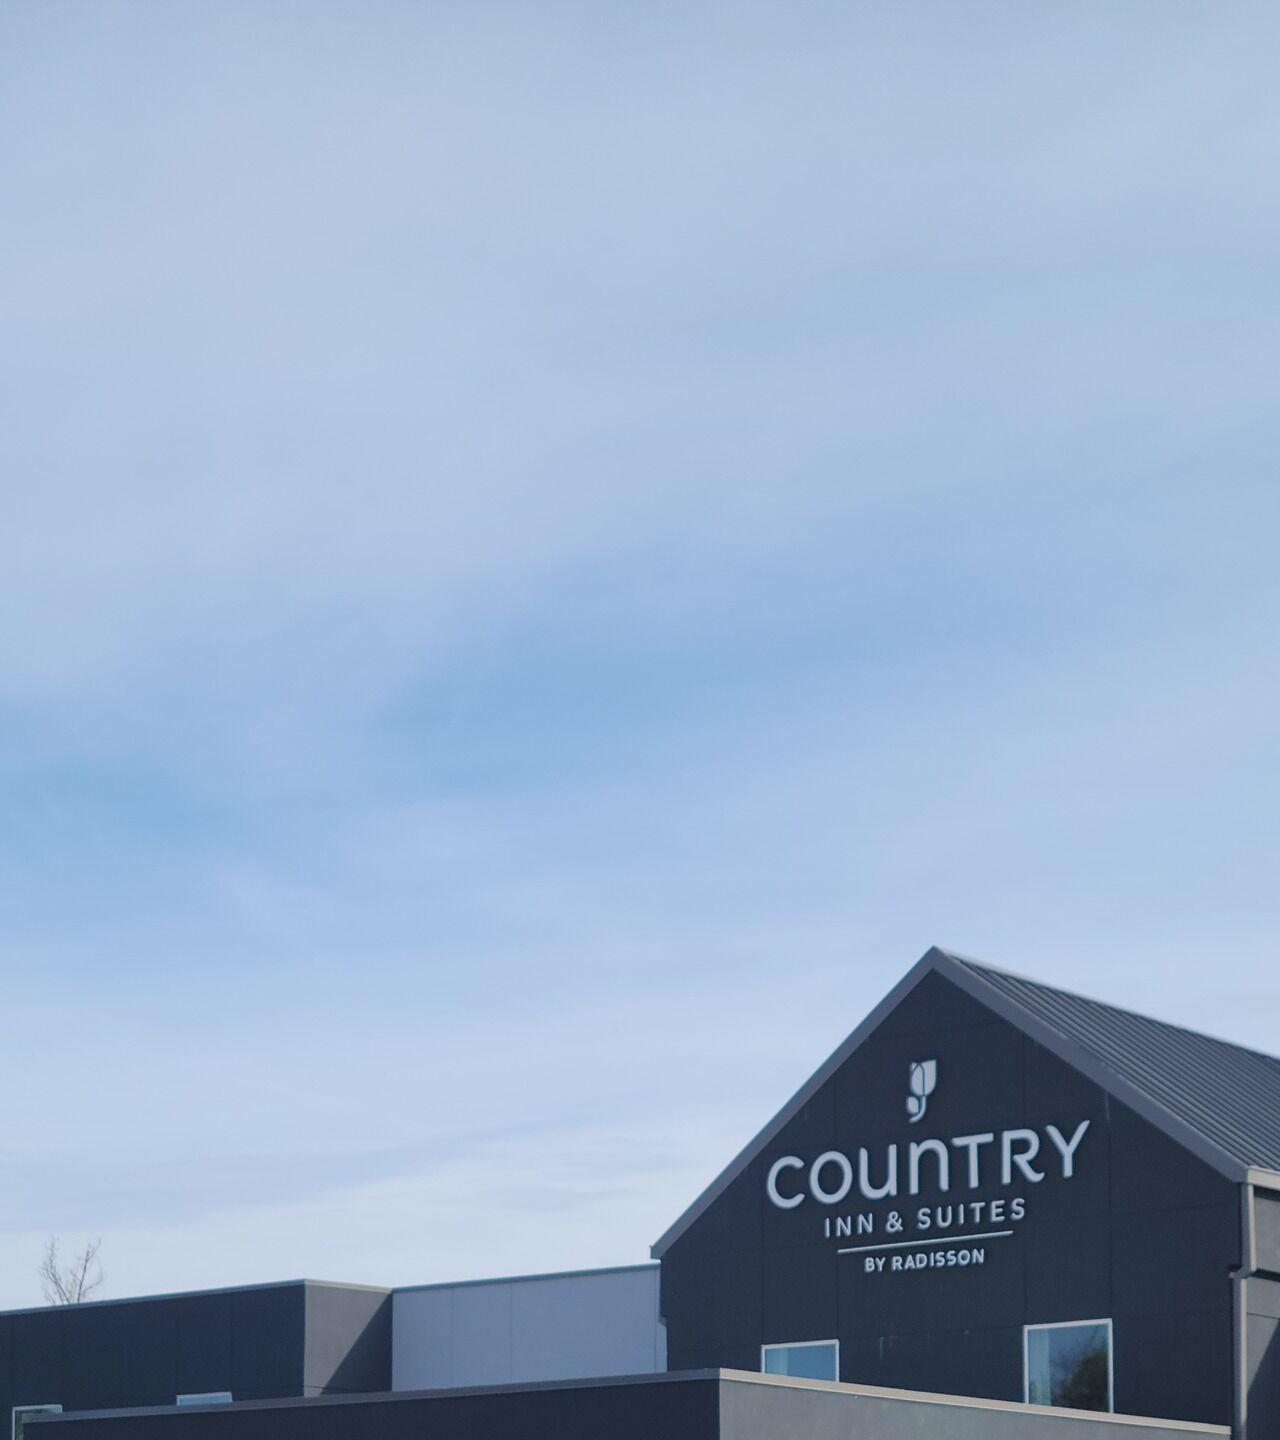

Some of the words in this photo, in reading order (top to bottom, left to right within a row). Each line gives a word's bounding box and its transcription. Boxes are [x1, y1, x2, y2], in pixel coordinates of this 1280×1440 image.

[767, 1119, 1090, 1209] COUNTRY
[825, 1213, 874, 1238] INN
[886, 1211, 904, 1232] &
[917, 1198, 1026, 1230] SUITES
[864, 1256, 886, 1273] BY
[891, 1248, 985, 1271] RADISSON
